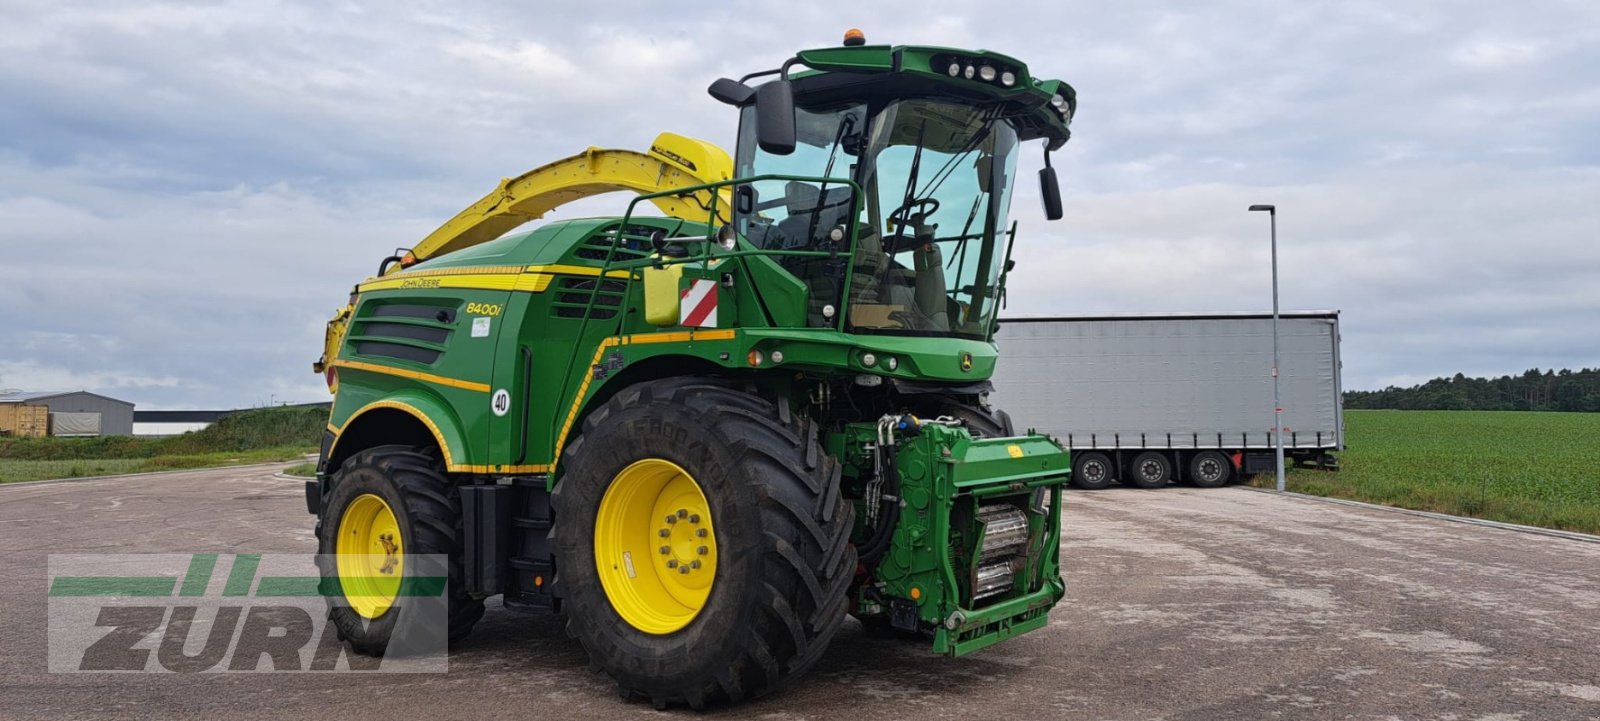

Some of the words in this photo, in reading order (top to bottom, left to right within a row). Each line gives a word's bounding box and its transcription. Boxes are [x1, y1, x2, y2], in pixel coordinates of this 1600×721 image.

[400, 279, 418, 288] JOHN
[418, 278, 441, 288] DEERE
[466, 302, 503, 316] 8400i
[495, 393, 507, 412] 40
